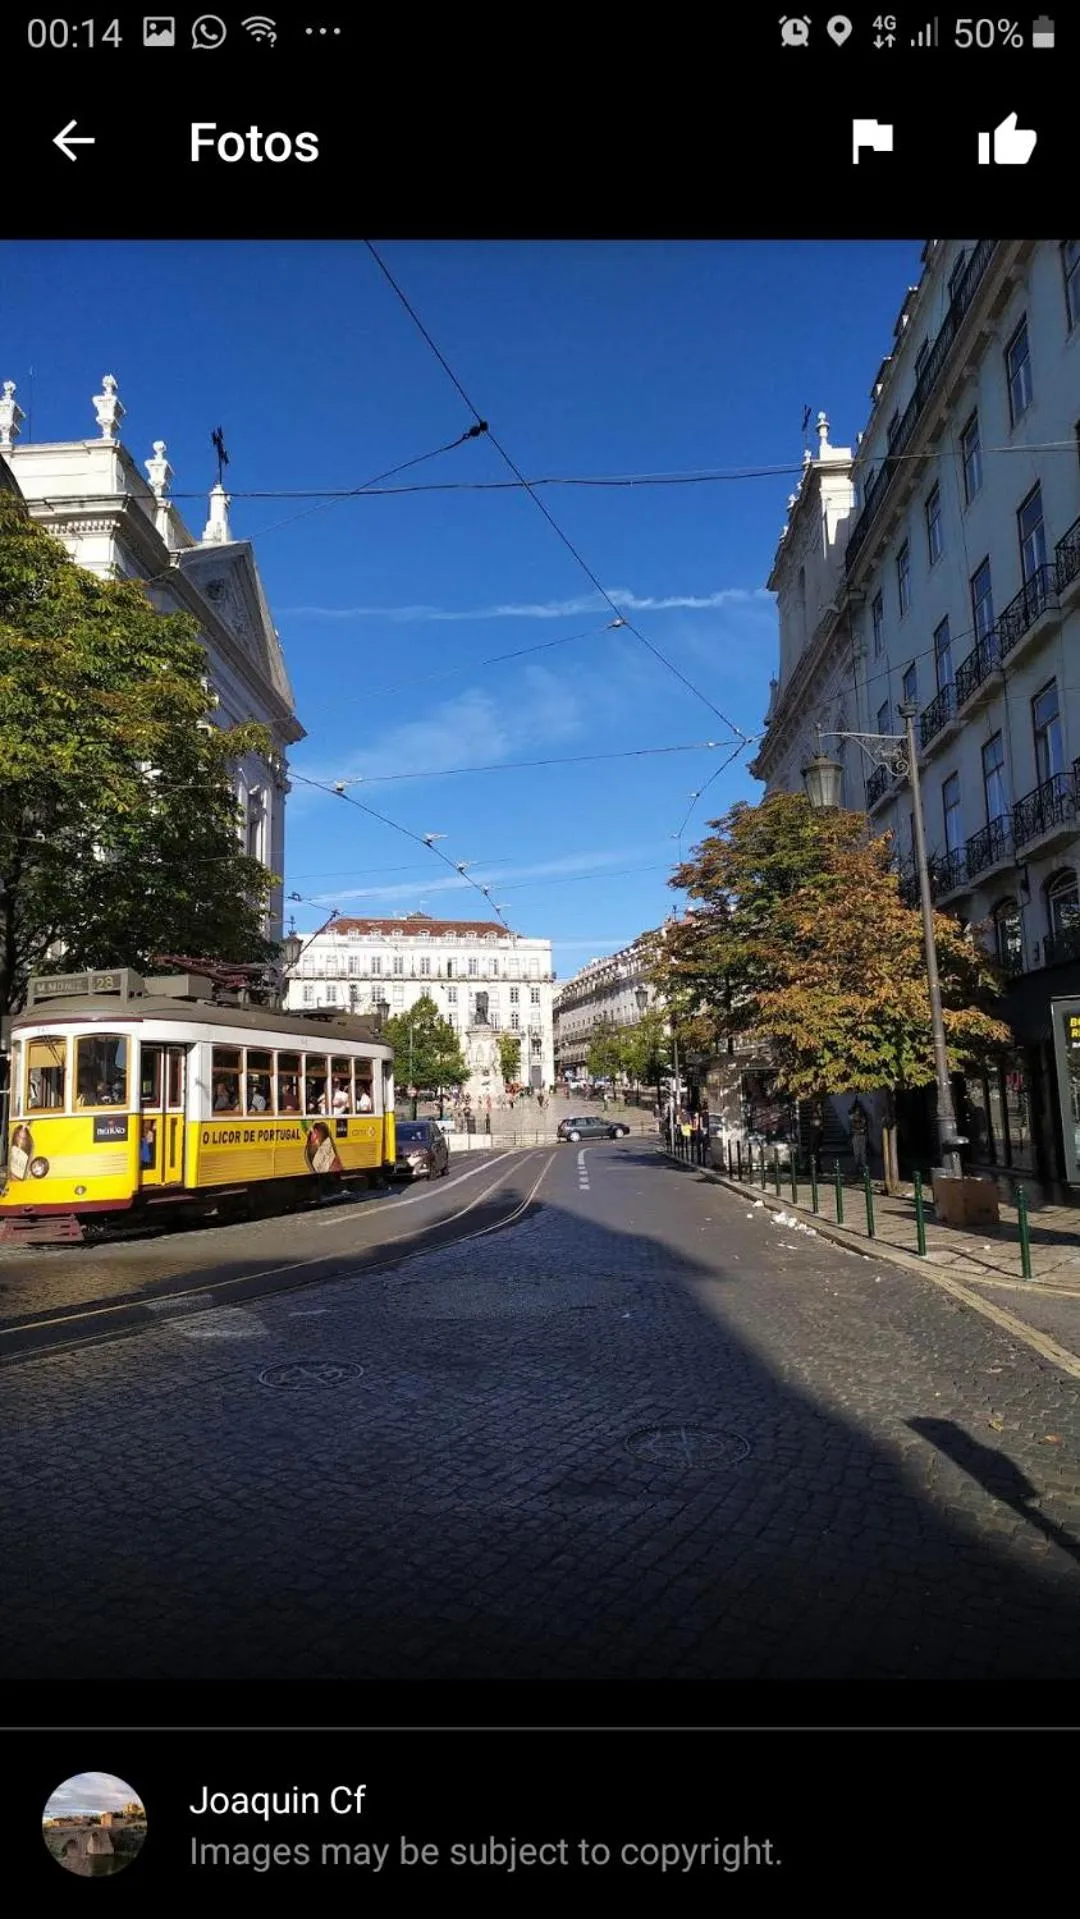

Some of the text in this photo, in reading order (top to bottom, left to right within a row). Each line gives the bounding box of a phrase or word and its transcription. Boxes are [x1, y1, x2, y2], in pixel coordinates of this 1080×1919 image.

[96, 975, 114, 989] 28
[203, 1128, 301, 1145] O LICOR DE PORTUGAL
